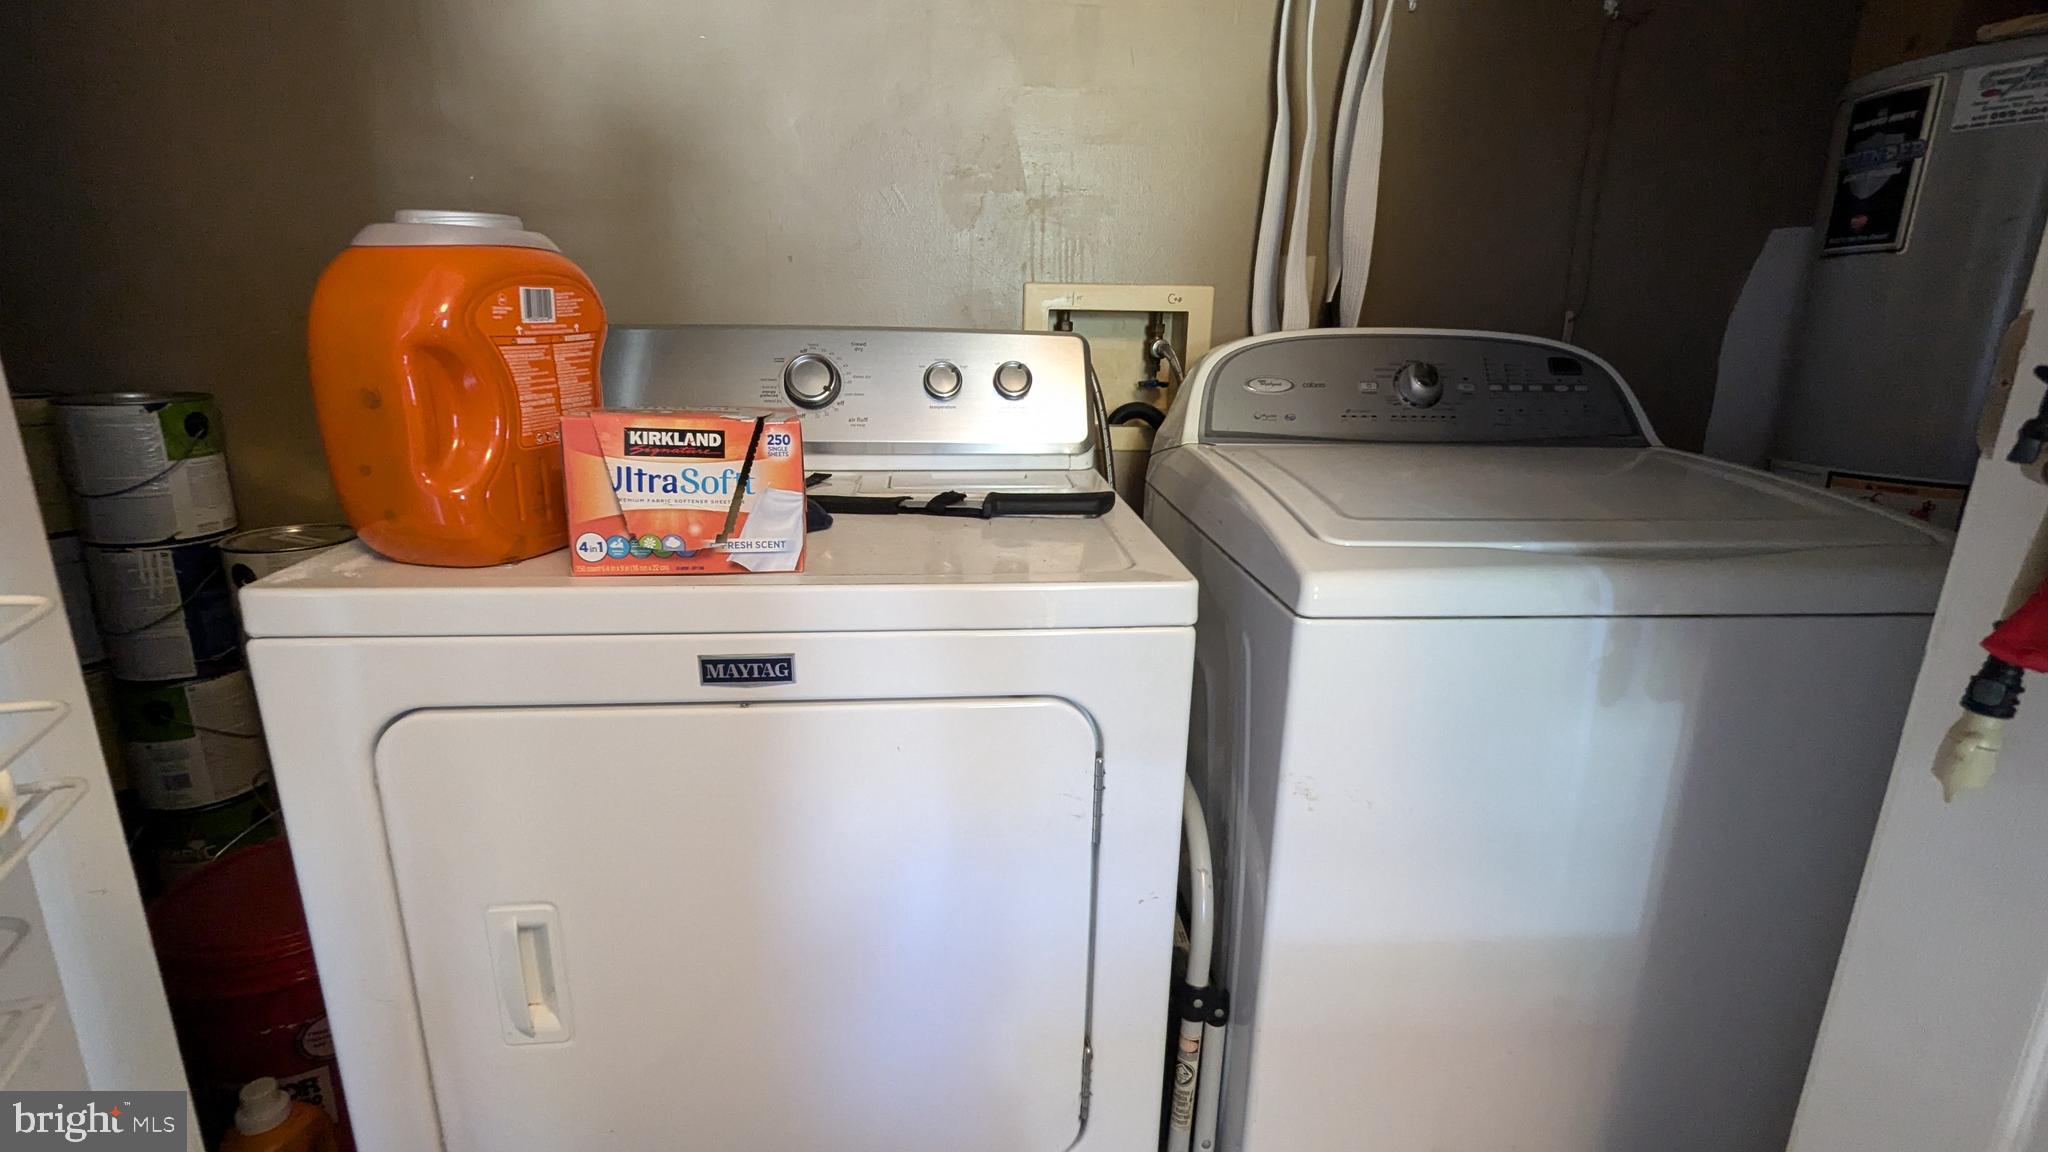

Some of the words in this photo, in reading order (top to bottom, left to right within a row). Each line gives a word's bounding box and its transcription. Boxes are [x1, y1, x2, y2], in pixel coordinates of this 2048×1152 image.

[629, 431, 722, 447] KIRKLAND
[767, 434, 791, 446] 250
[629, 444, 722, 456] Signature
[755, 540, 786, 549] SCENT
[704, 662, 789, 679] MAYTAG
